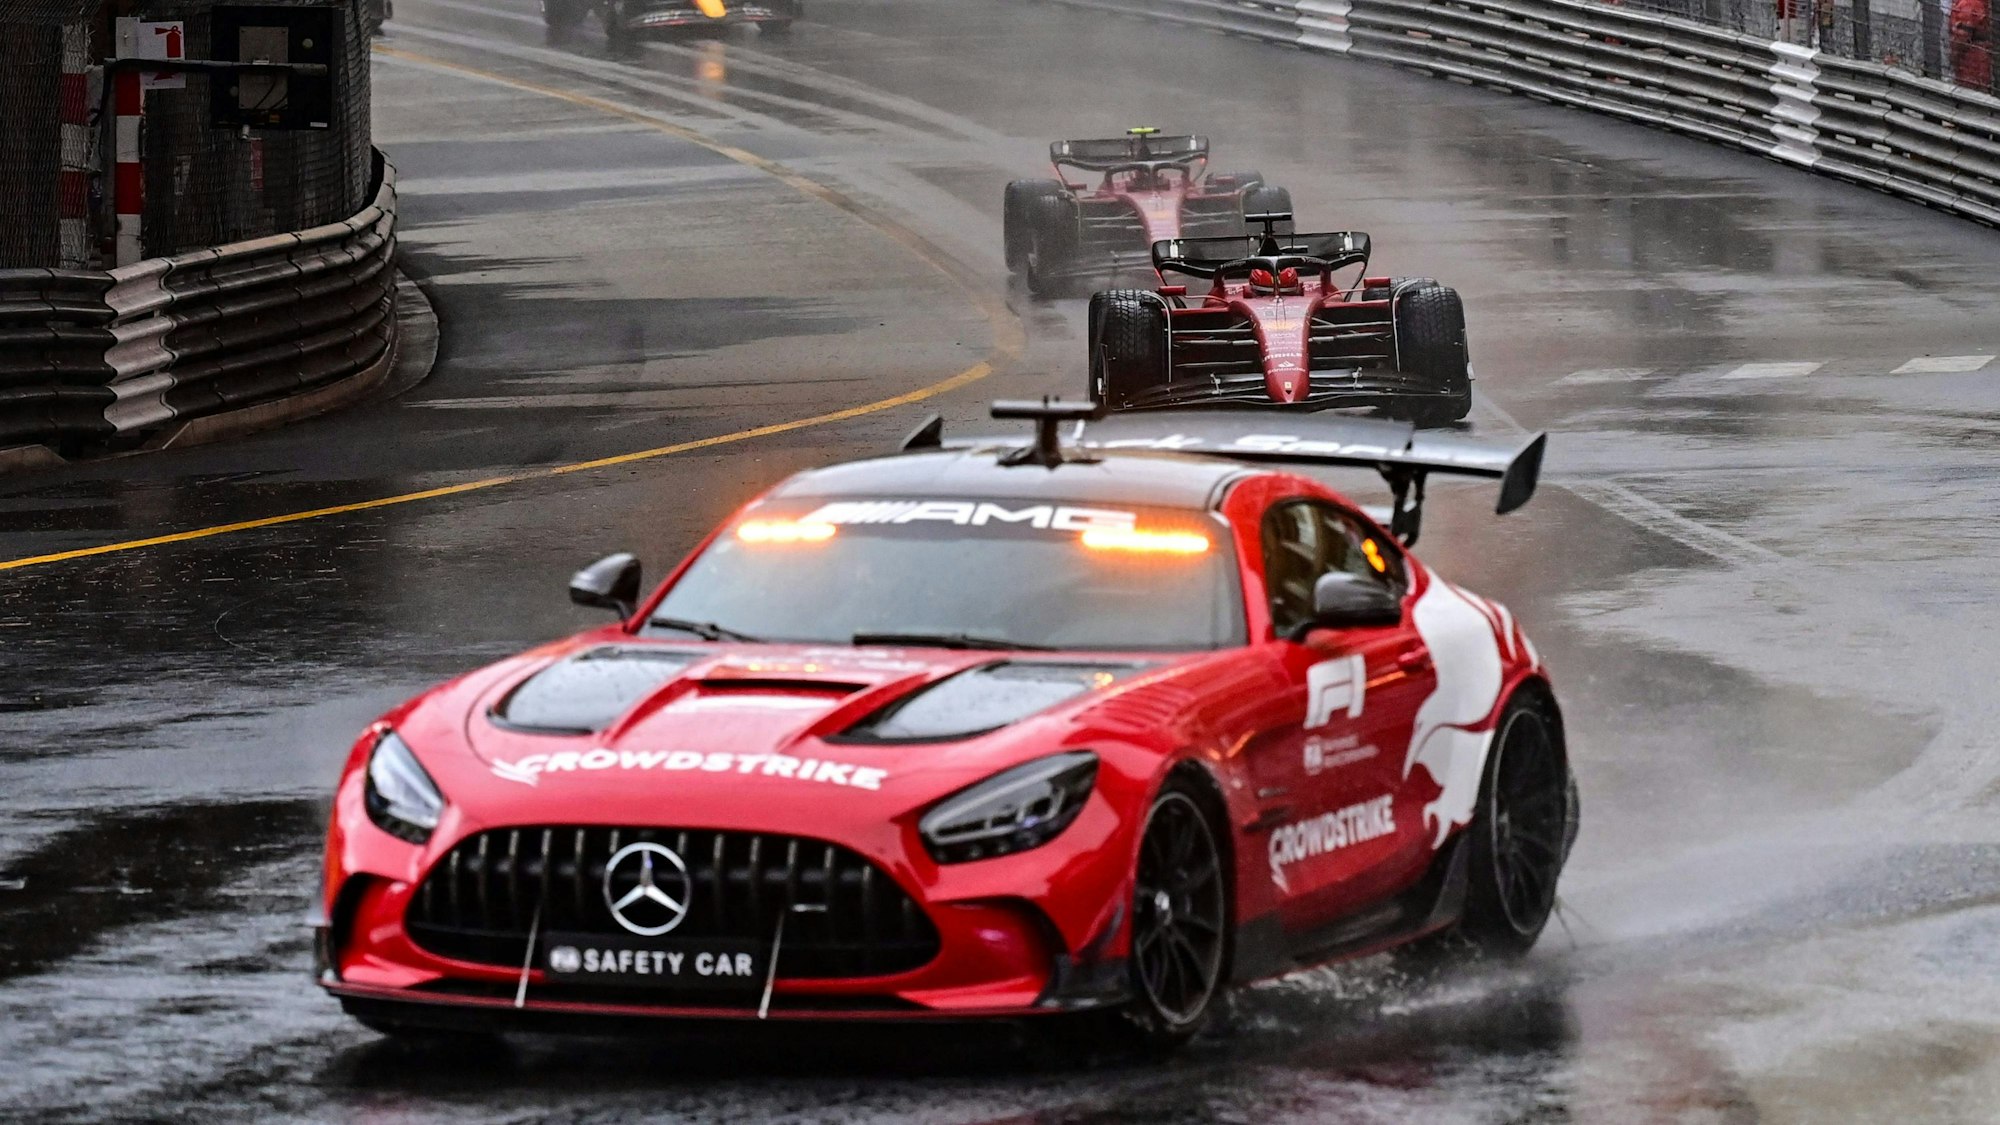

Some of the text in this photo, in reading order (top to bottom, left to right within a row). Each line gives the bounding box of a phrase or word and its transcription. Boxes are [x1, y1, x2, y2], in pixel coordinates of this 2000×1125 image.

[898, 500, 1136, 532] AMG
[491, 749, 888, 791] CROWDSTRIKE
[1268, 793, 1397, 895] CROWDSTRIKE
[583, 947, 685, 975] SAFETY
[694, 951, 753, 977] CAR
